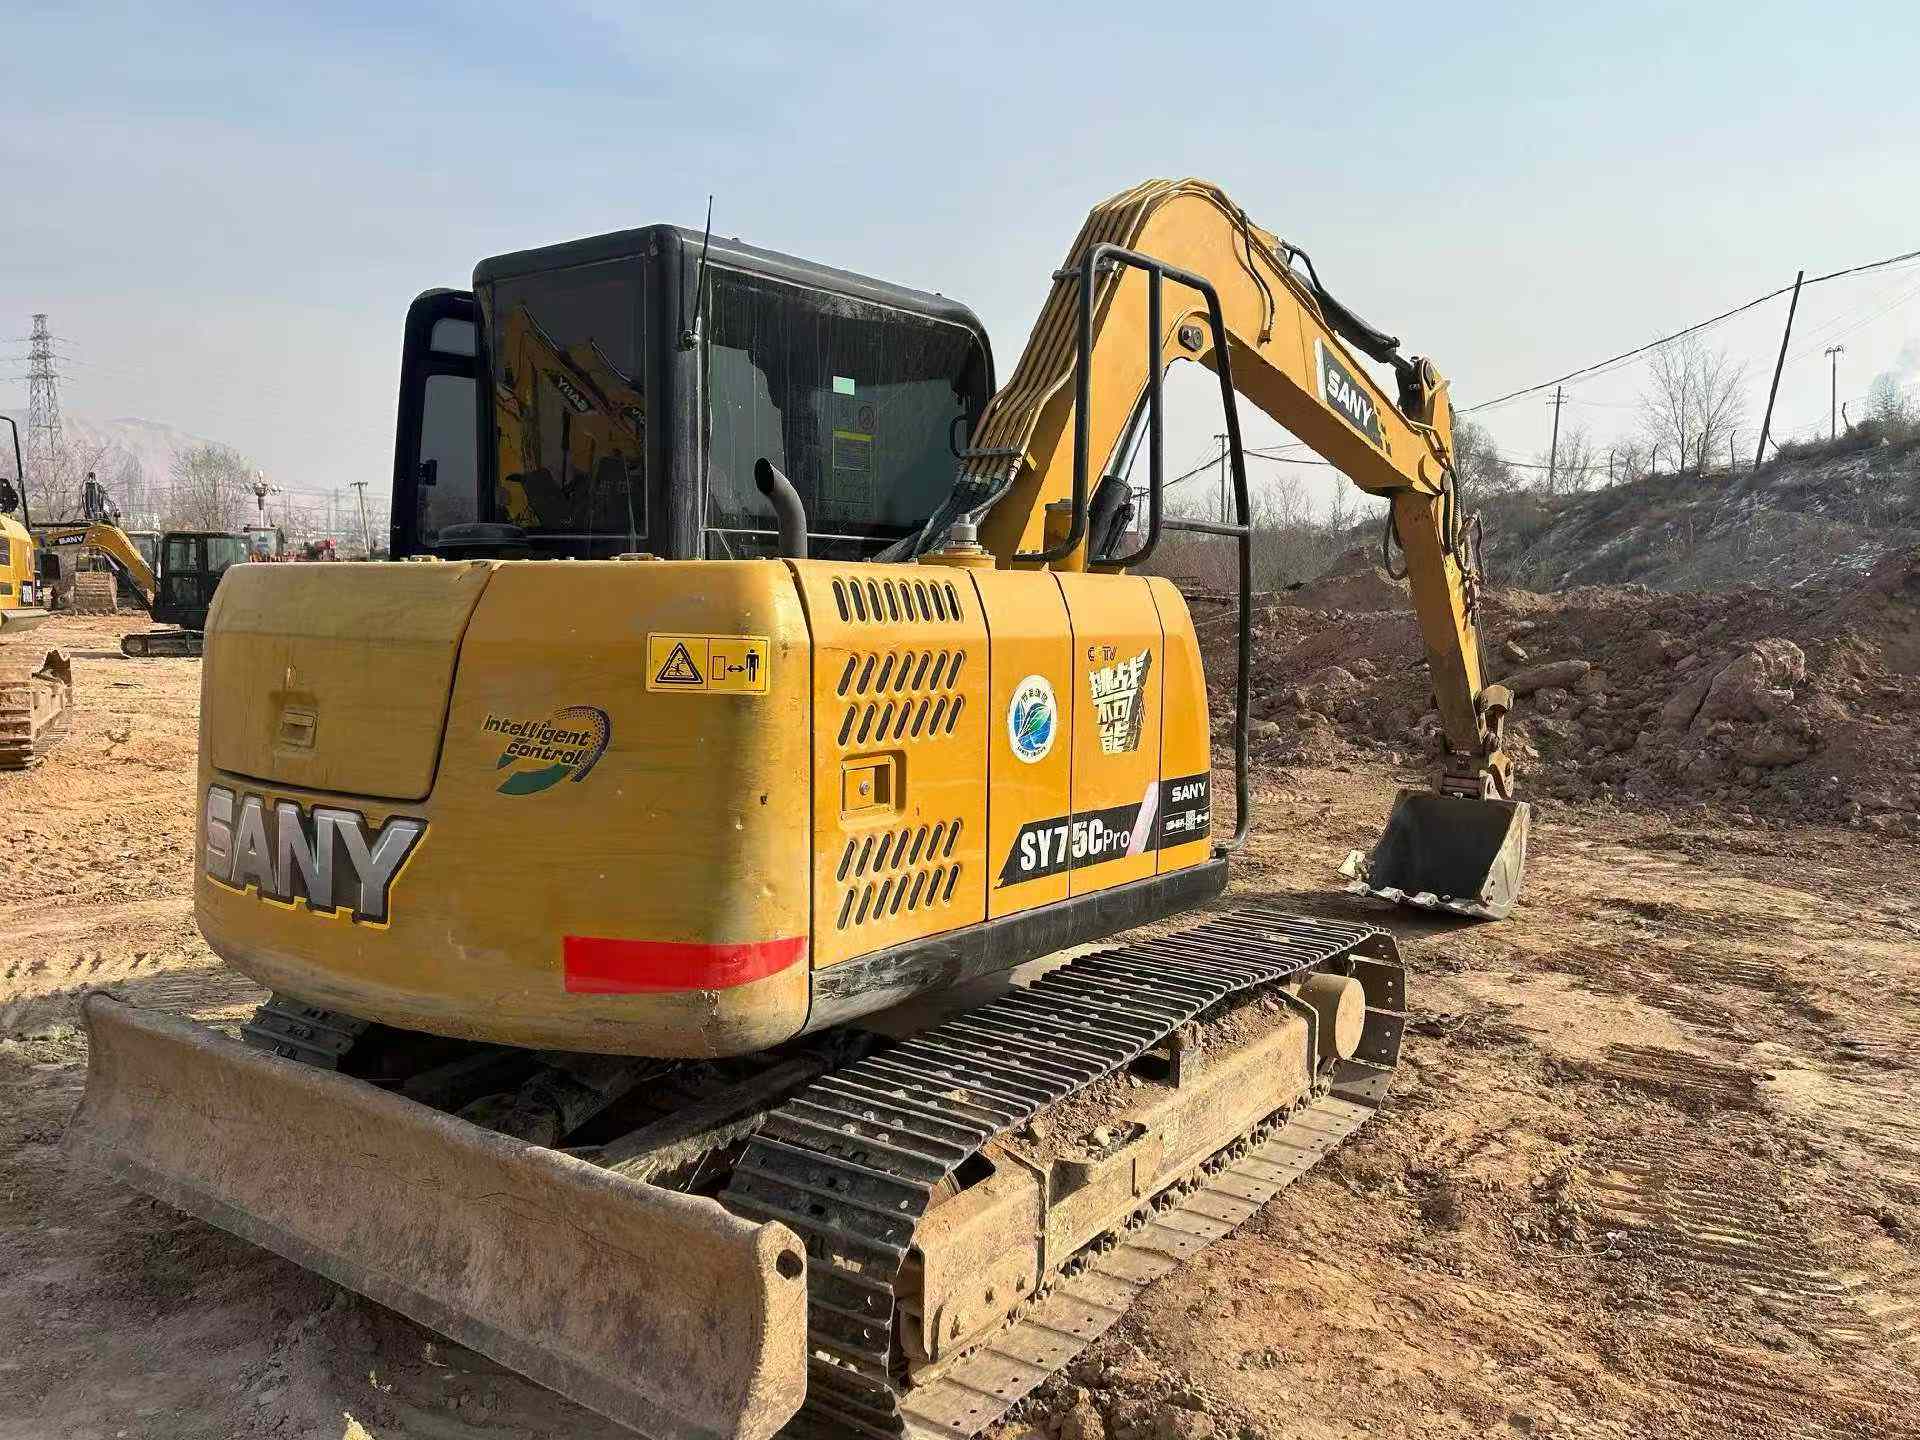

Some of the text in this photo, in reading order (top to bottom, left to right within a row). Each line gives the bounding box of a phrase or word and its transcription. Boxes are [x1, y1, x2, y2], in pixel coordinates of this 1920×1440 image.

[1326, 369, 1373, 427] SANY
[59, 535, 83, 545] SANY
[1087, 646, 1116, 662] CTV
[505, 742, 589, 766] control
[1171, 781, 1206, 803] SANY
[205, 785, 431, 922] SANY
